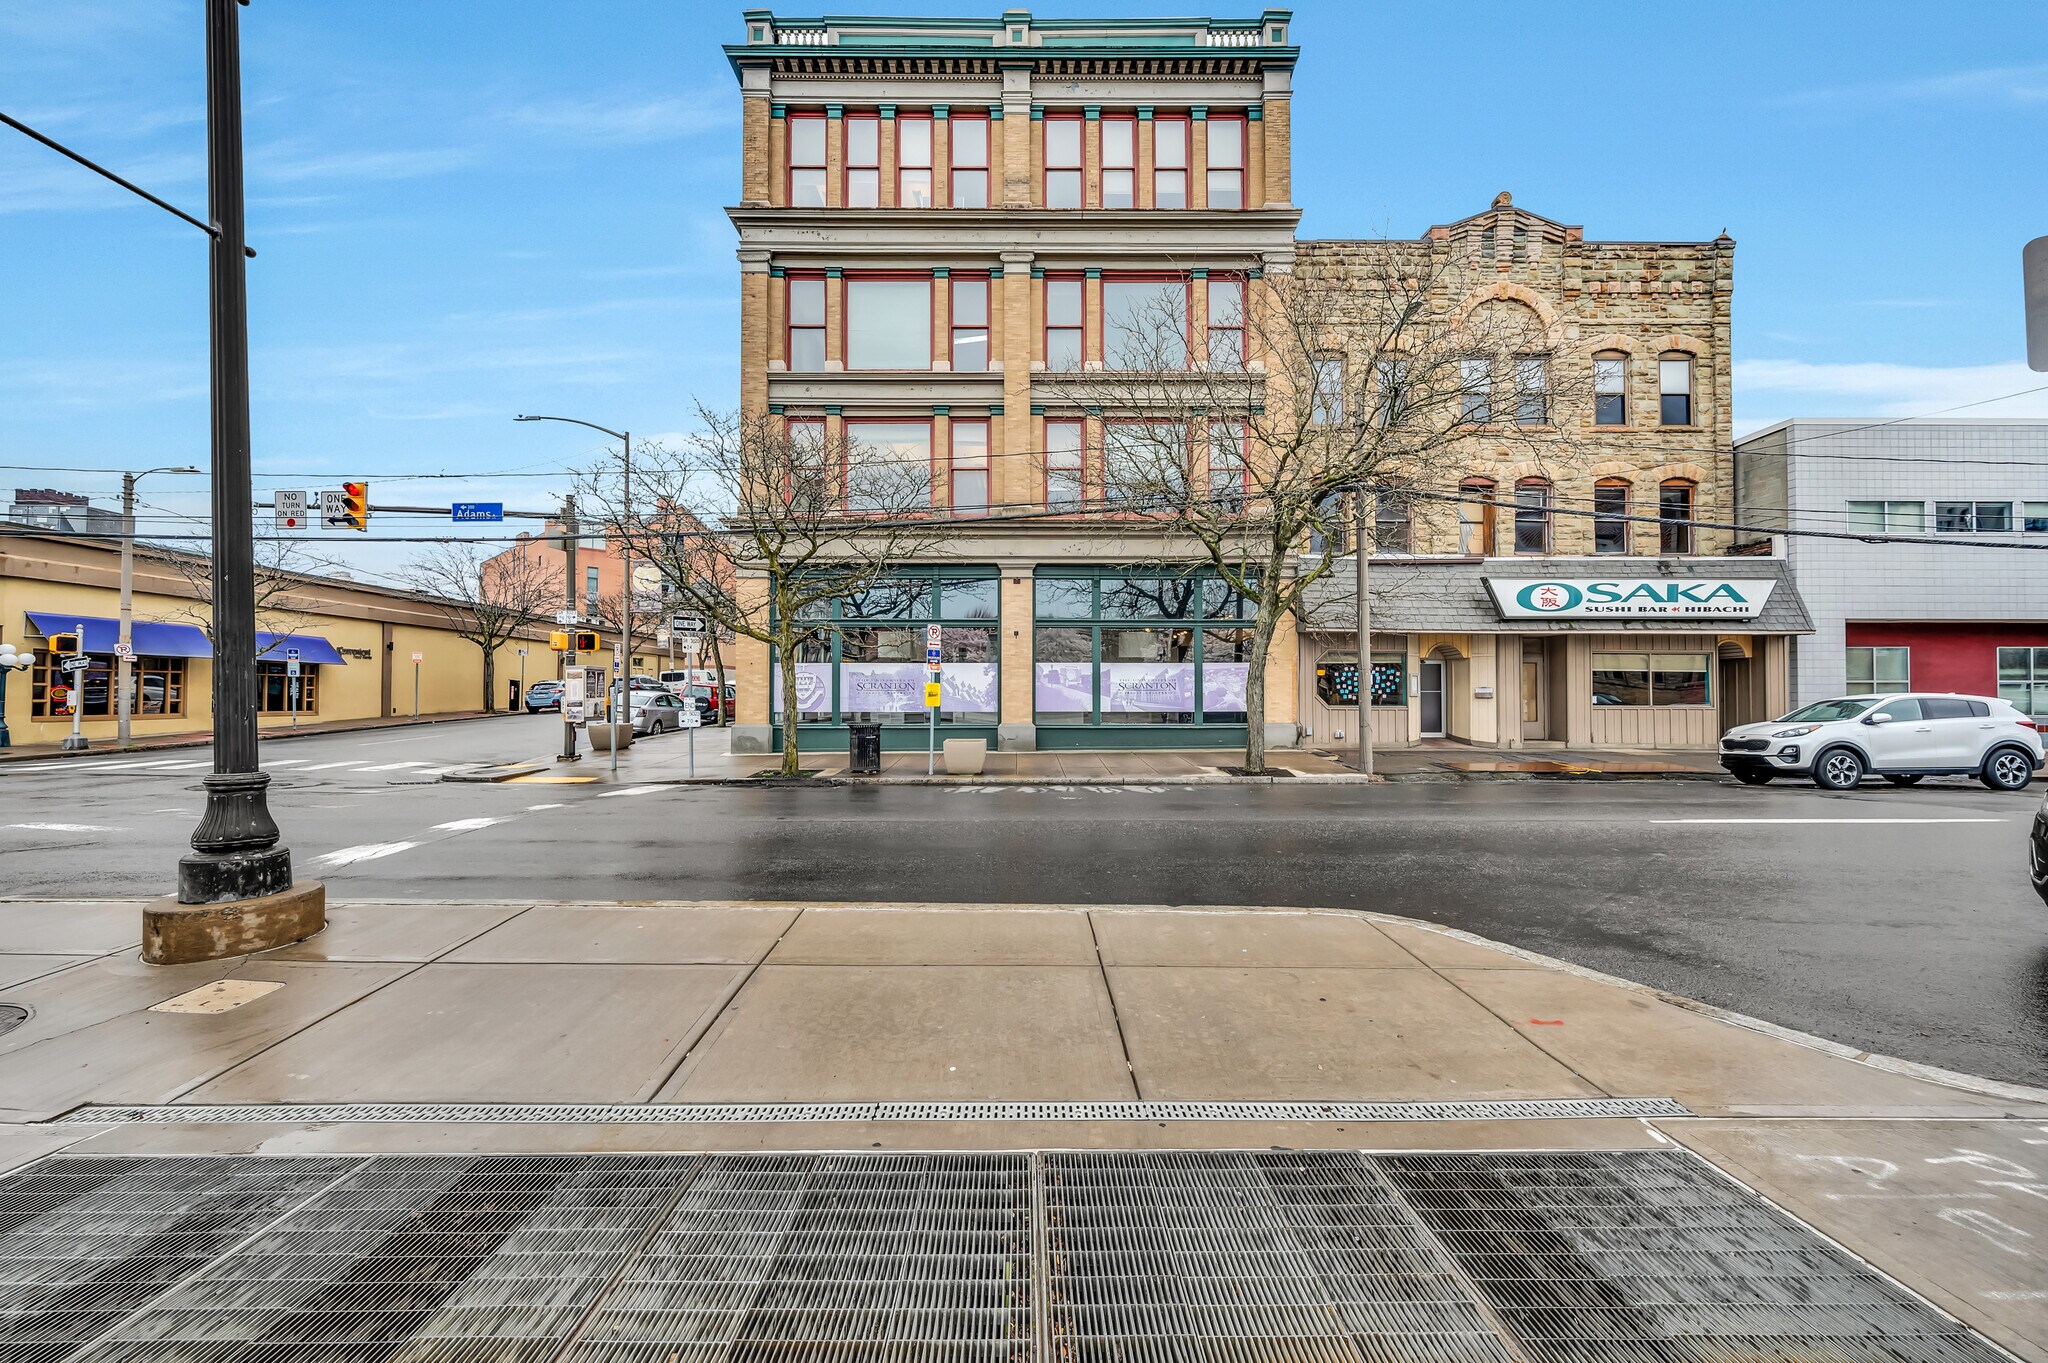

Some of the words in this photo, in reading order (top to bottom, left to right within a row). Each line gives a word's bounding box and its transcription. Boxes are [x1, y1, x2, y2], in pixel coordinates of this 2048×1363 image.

[284, 493, 297, 501] NO
[327, 494, 347, 503] ONE
[326, 504, 347, 513] WAY
[456, 509, 491, 520] Adams
[1516, 582, 1748, 612] OSAKA
[856, 682, 916, 691] SCRANTON
[1118, 682, 1177, 691] SCRANTON
